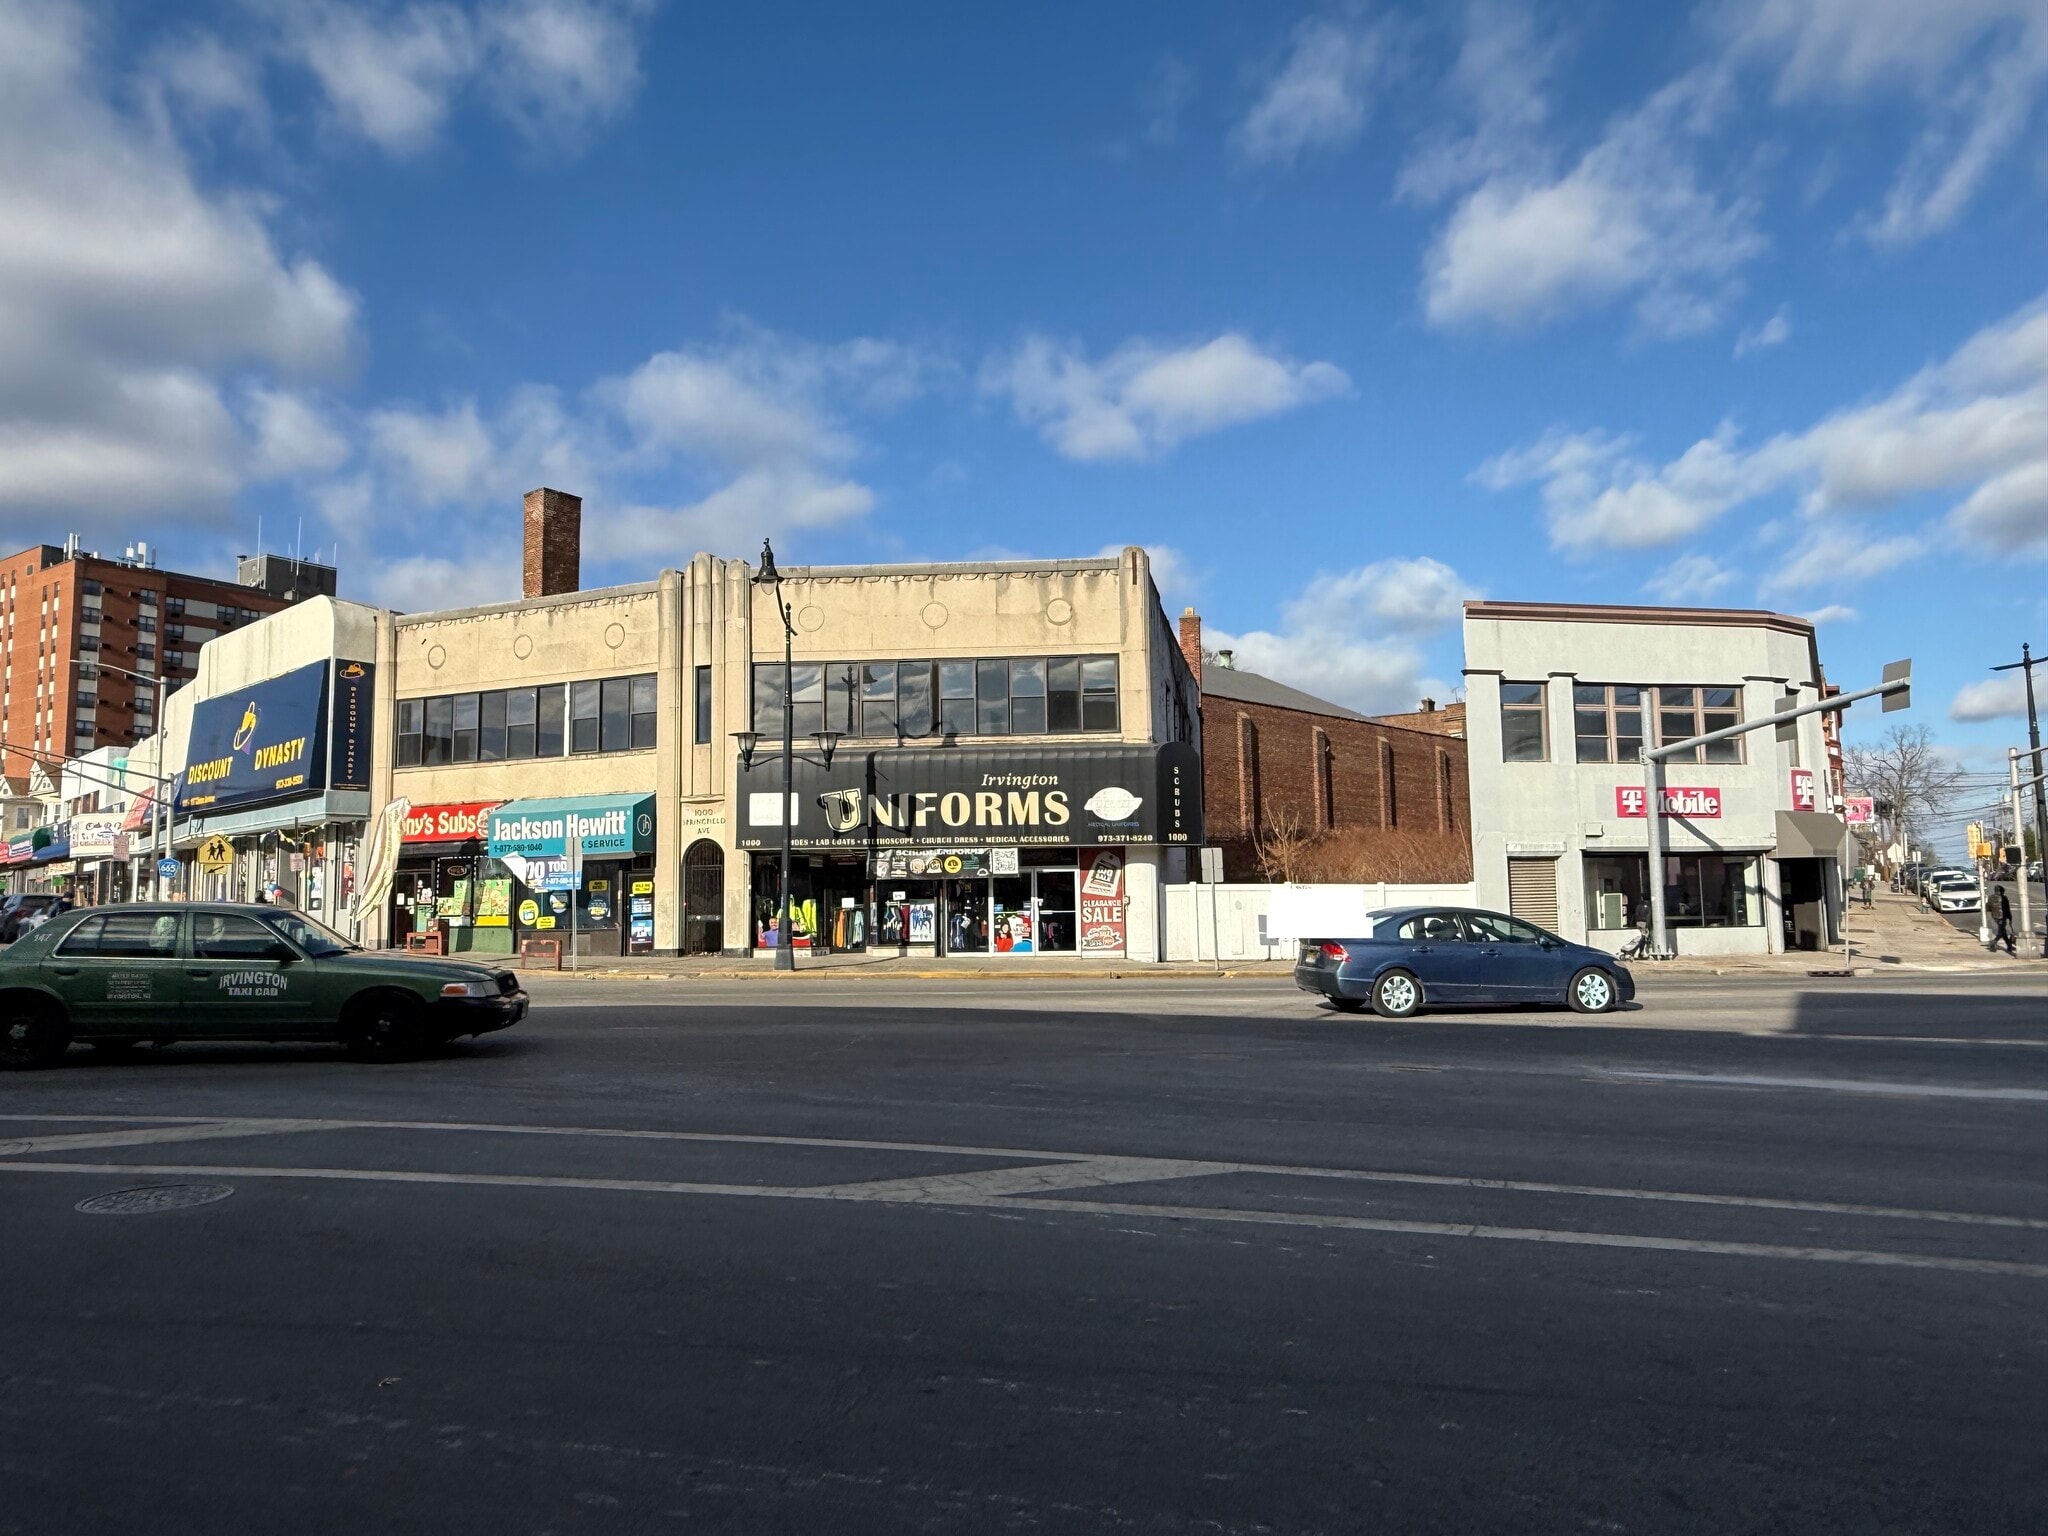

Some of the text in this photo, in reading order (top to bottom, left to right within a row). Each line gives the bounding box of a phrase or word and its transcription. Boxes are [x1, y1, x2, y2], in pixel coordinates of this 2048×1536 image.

[347, 686, 357, 780] DISCOUNT DYNASTY
[188, 737, 306, 785] DISCOUNT DYNASTY
[981, 773, 1059, 789] Irvington
[1173, 767, 1181, 828] SCRUBS
[1622, 790, 1643, 813] T
[694, 808, 714, 816] 1000
[820, 788, 1070, 832] UNIFORMS
[404, 810, 476, 836] ny's Subs
[493, 810, 626, 841] Jackson Hewitt
[683, 817, 726, 826] SPRINGFIELD
[588, 839, 625, 848] SERVICE
[816, 838, 829, 846] LAB
[832, 838, 855, 846] COATS
[863, 837, 914, 846] STETHOSCOPE
[922, 836, 952, 844] CHURCH
[954, 836, 978, 844] DRESS
[986, 836, 1018, 844] MEDICAL
[1098, 834, 1153, 842] 973-371-8240
[1168, 833, 1188, 841] 1000
[160, 864, 176, 872] 665
[548, 861, 568, 872] TOD
[1082, 907, 1122, 923] SALE
[219, 972, 288, 990] IRVINGTON
[228, 987, 278, 996] TAXI CAB
